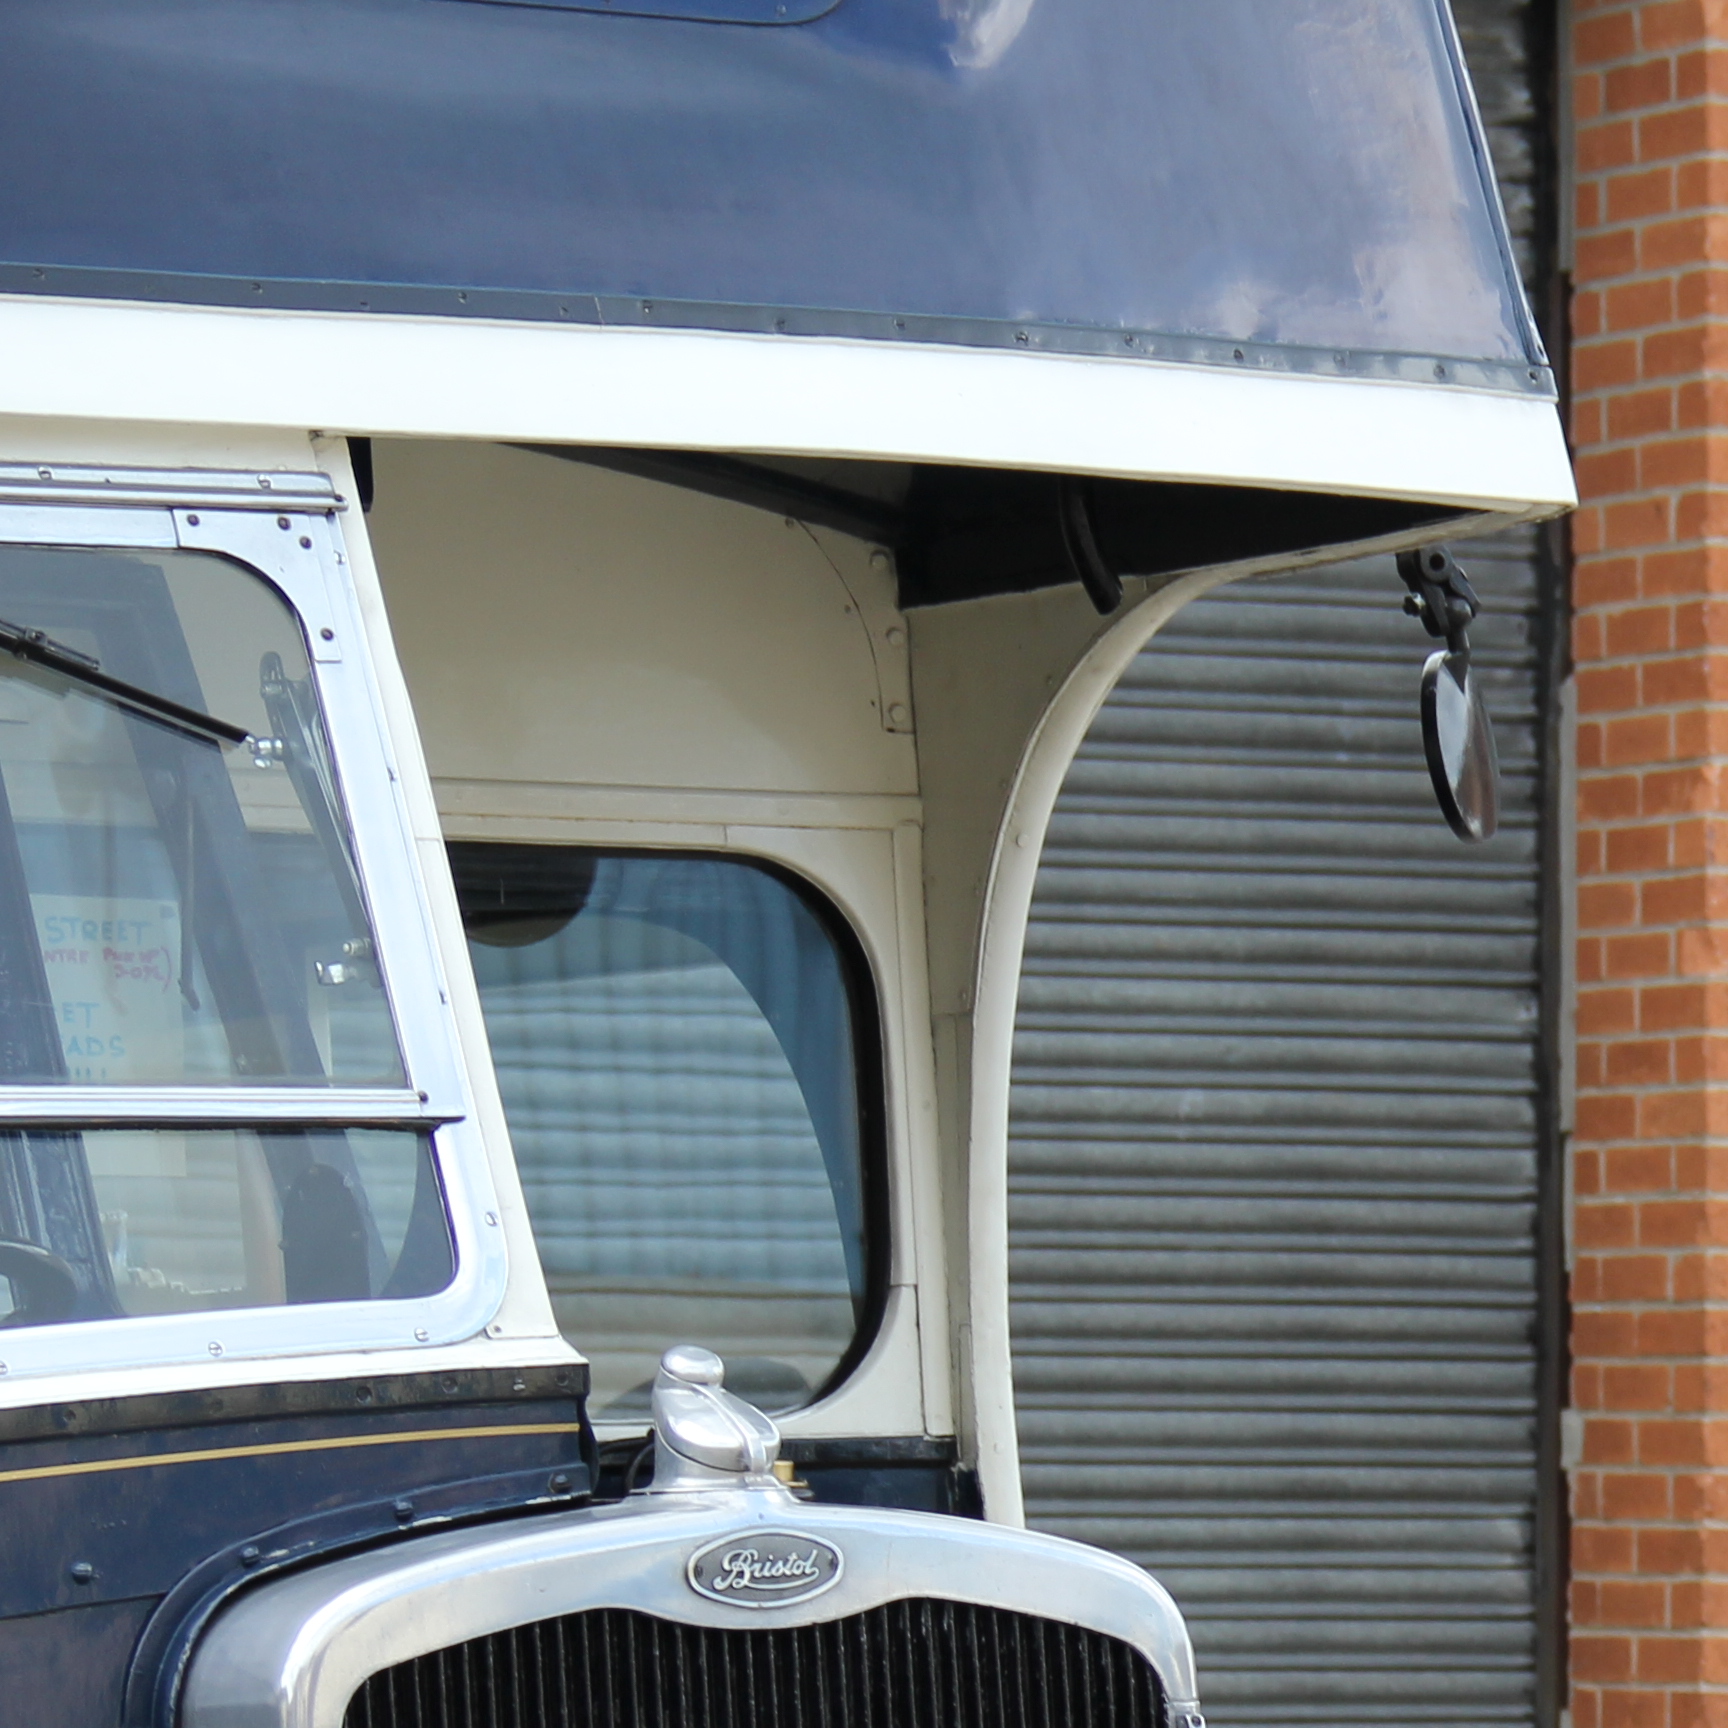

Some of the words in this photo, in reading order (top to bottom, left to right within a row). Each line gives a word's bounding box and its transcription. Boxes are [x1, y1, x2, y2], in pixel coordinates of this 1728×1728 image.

[44, 950, 89, 963] NTRE
[62, 1002, 99, 1028] ET
[66, 1034, 125, 1058] ADS
[712, 1549, 820, 1591] Bristol
